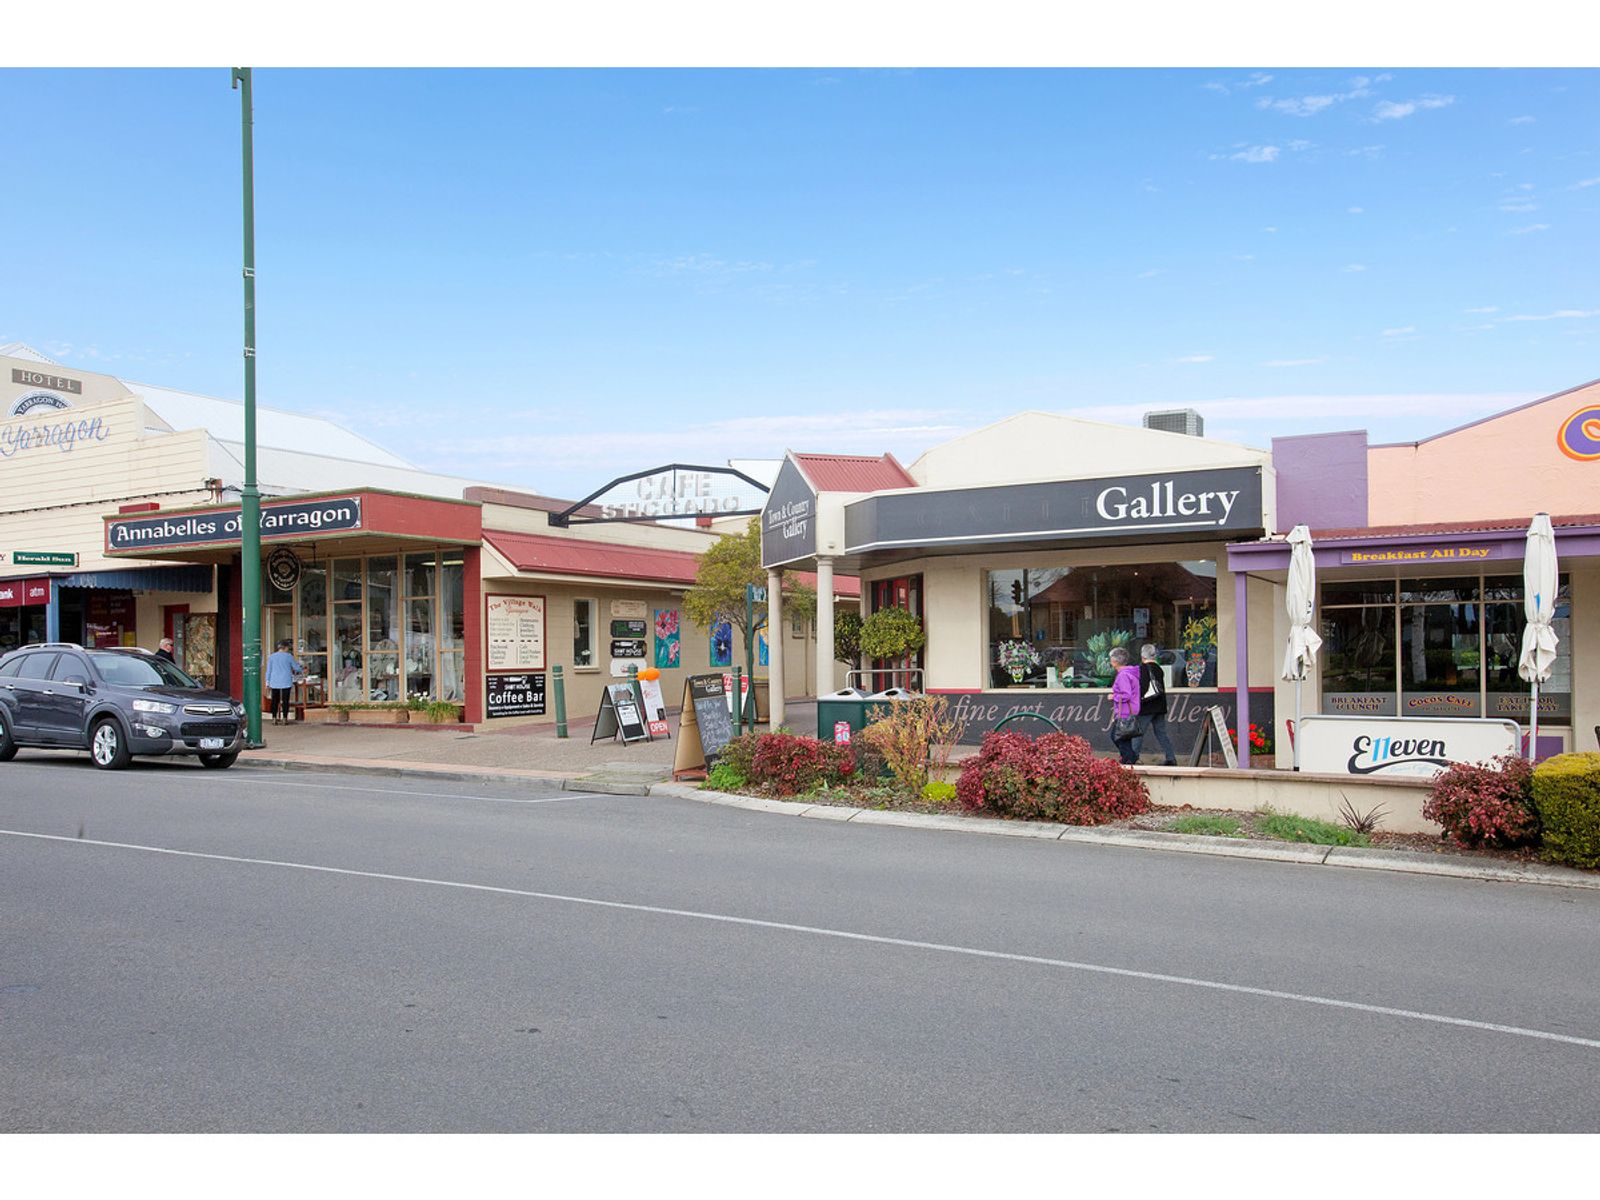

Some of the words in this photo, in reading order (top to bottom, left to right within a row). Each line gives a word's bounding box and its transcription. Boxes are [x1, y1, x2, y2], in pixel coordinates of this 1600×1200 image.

[21, 370, 74, 390] HOTEL
[637, 474, 711, 500] CAFE
[1096, 480, 1240, 526] Gallery
[116, 519, 216, 542] Annabelles
[783, 516, 807, 540] Gallery
[1351, 551, 1427, 561] Breakfast
[1430, 548, 1455, 558] All
[1458, 547, 1490, 558] Day
[29, 587, 45, 598] atm
[489, 691, 524, 704] Coffee
[526, 691, 544, 702] Bar
[950, 694, 998, 728] fine
[1004, 700, 1045, 721] art
[1050, 694, 1104, 721] and
[650, 721, 667, 732] OPEN
